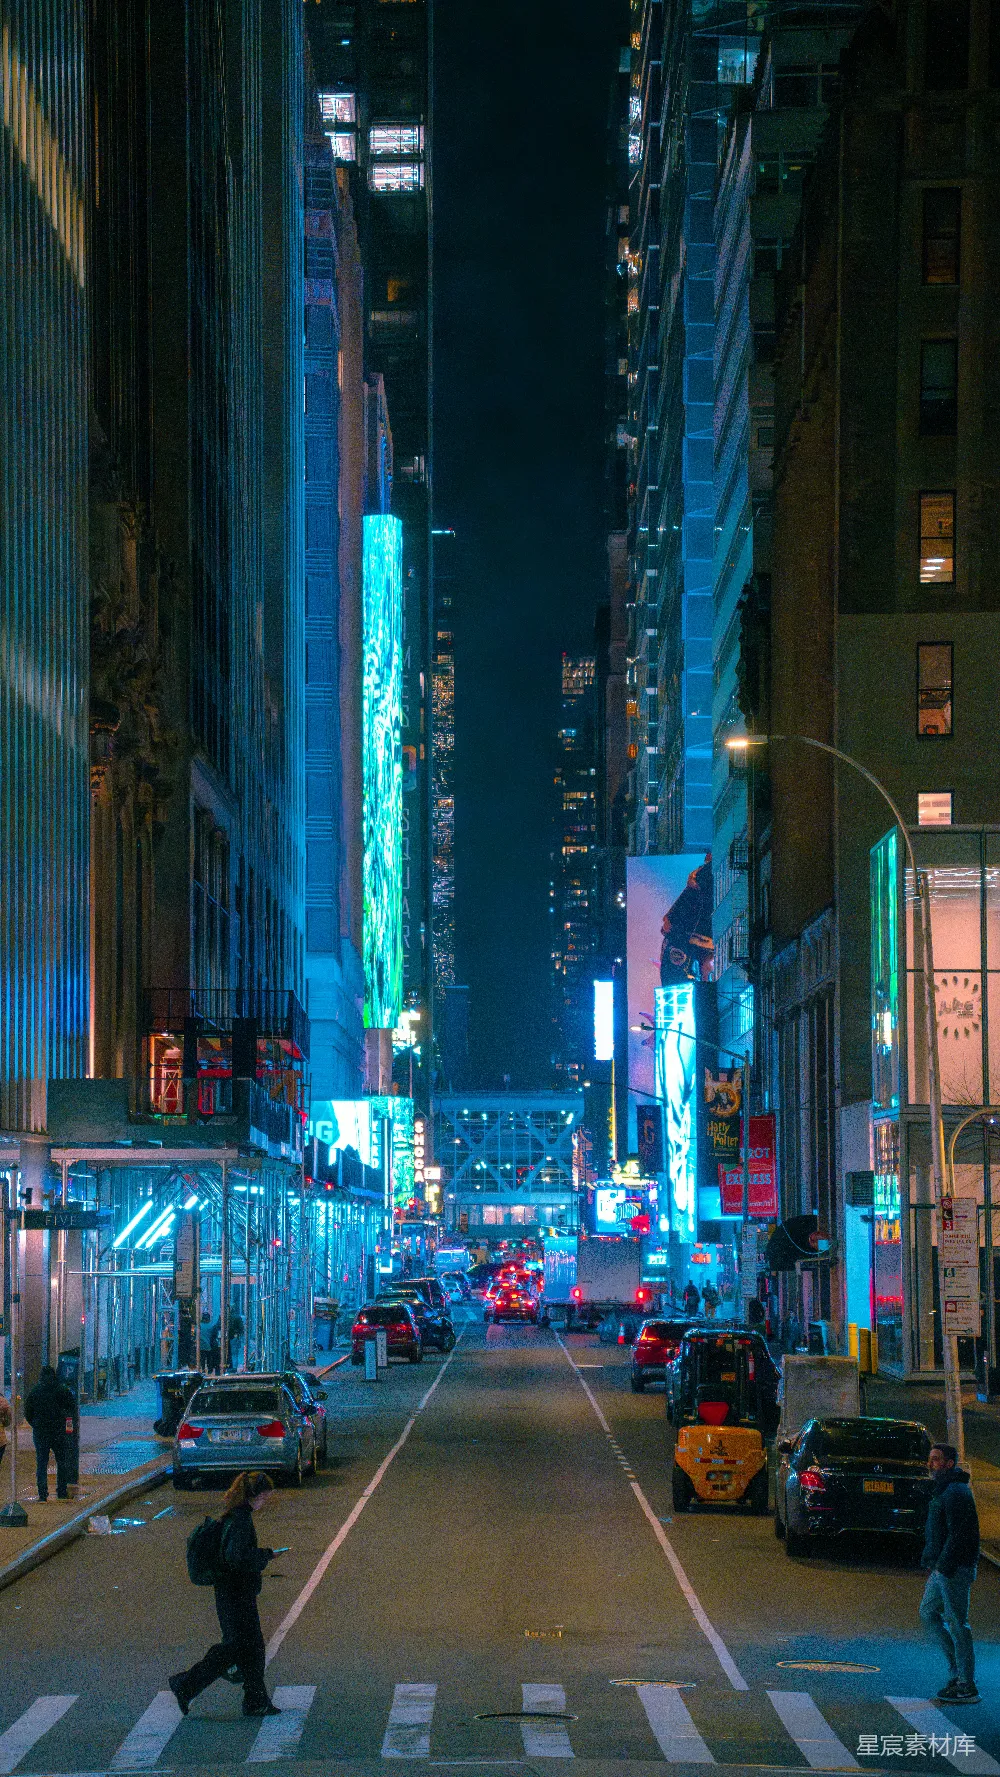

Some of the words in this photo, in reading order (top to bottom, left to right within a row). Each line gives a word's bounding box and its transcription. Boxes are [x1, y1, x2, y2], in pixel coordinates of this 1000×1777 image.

[707, 1120, 731, 1137] Harry
[713, 1133, 739, 1149] Potter
[414, 1121, 424, 1182] SHOCA
[45, 1214, 77, 1226] FIVE
